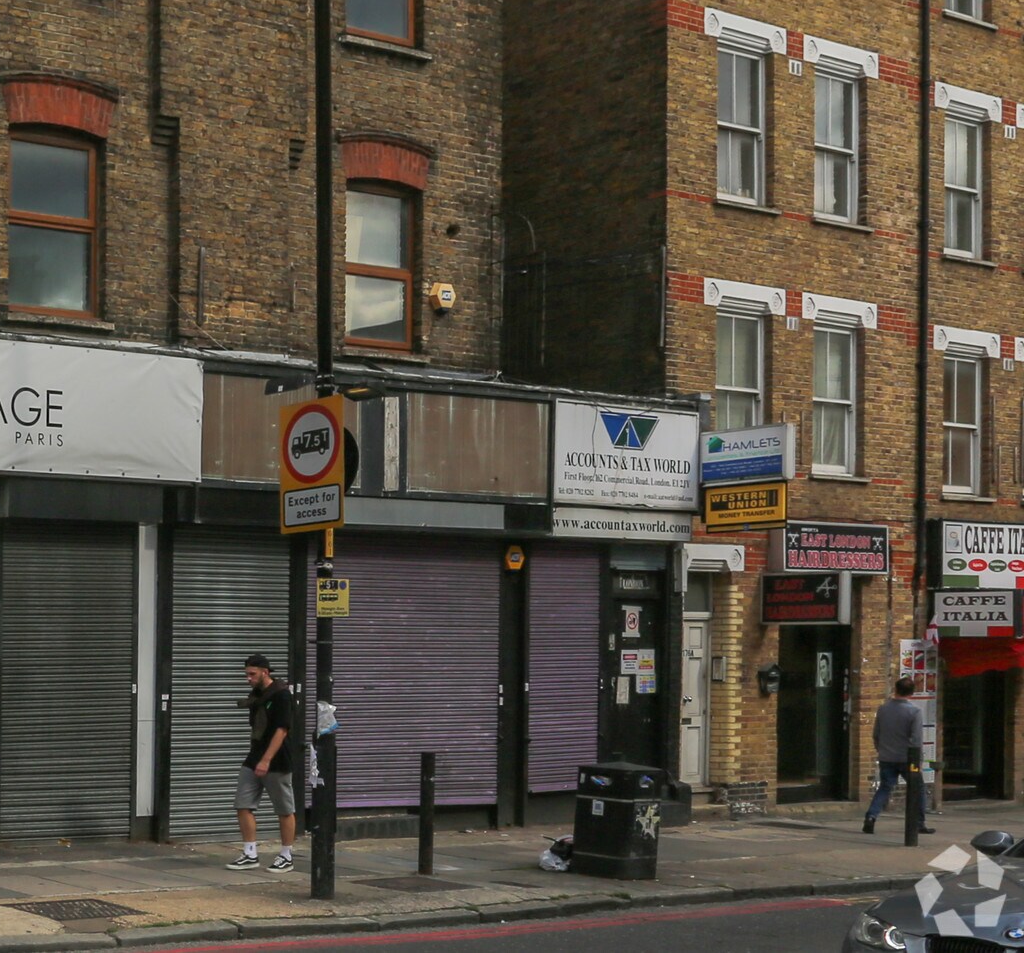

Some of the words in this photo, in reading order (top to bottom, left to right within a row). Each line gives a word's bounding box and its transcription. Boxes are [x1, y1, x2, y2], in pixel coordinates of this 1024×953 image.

[15, 431, 64, 447] PARIS
[722, 437, 781, 452] HAMLETS
[565, 451, 618, 471] ACCOUNTS
[620, 456, 628, 471] &
[630, 456, 651, 472] TAX
[654, 458, 691, 475] WORLD
[564, 471, 577, 481] First
[603, 474, 635, 485] Commercial
[288, 495, 320, 507] Except
[322, 491, 336, 503] for
[711, 491, 767, 502] WESTERN
[728, 499, 767, 509] UNION
[296, 507, 327, 519] access
[742, 509, 775, 517] TRANSFER
[553, 513, 690, 534] www.accountaxworld.com
[801, 533, 828, 547] EAST
[828, 534, 871, 549] LONDON
[964, 525, 1004, 554] CAFFE
[787, 549, 884, 570] HAIRDRESSERS
[942, 596, 1006, 606] CAFFE
[943, 611, 1009, 622] ITALIA
